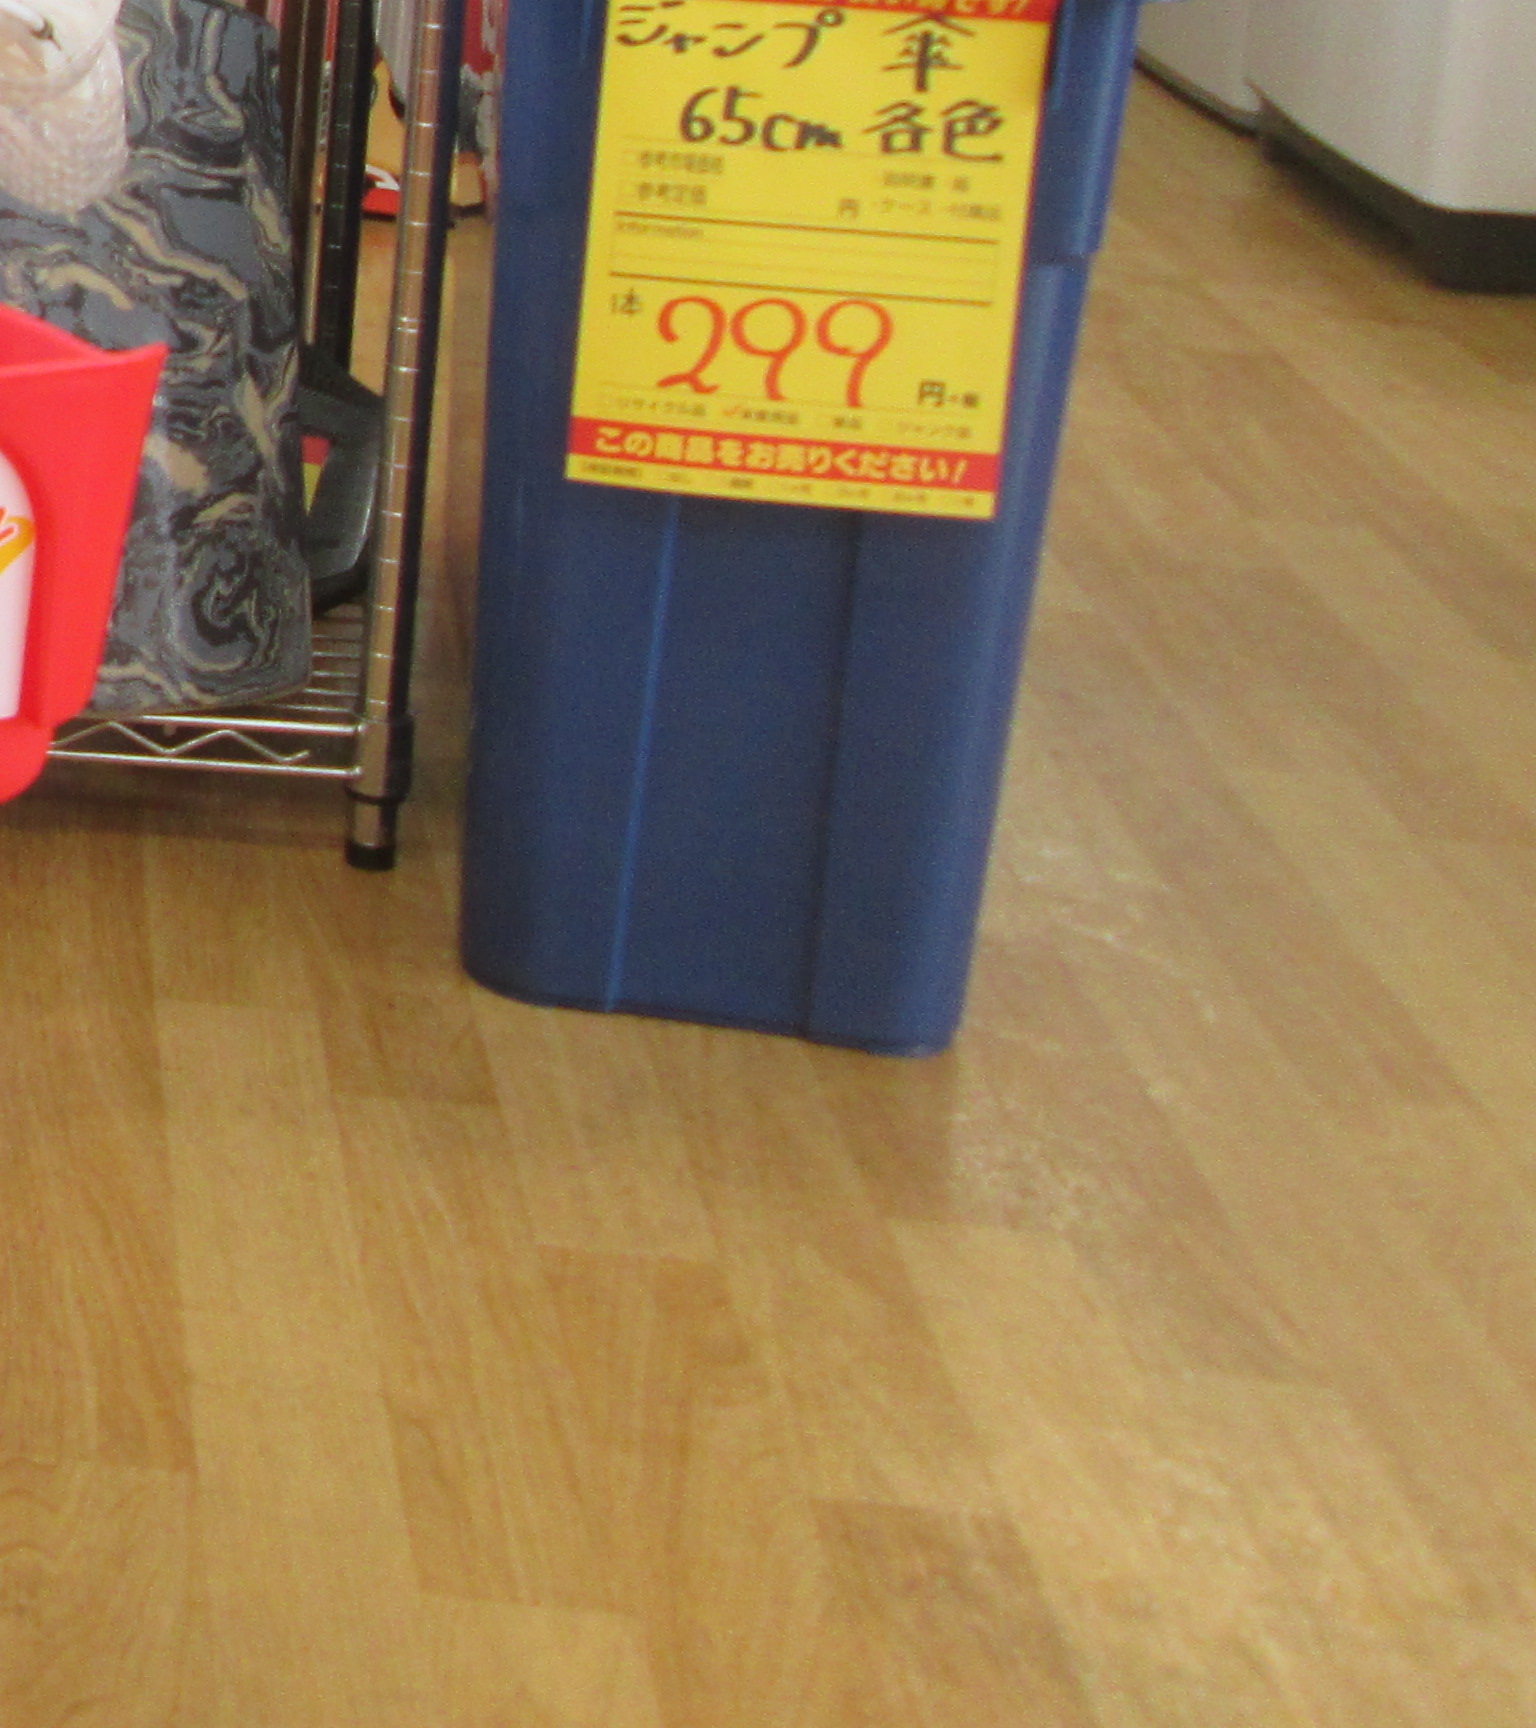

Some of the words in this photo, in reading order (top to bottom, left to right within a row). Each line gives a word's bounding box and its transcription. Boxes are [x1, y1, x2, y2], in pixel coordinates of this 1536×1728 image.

[614, 0, 846, 69] ジャンプ
[678, 85, 845, 152] 65cm
[862, 98, 1004, 162] 各色
[656, 295, 895, 409] 299
[594, 425, 968, 486] この商品をお売りください!
